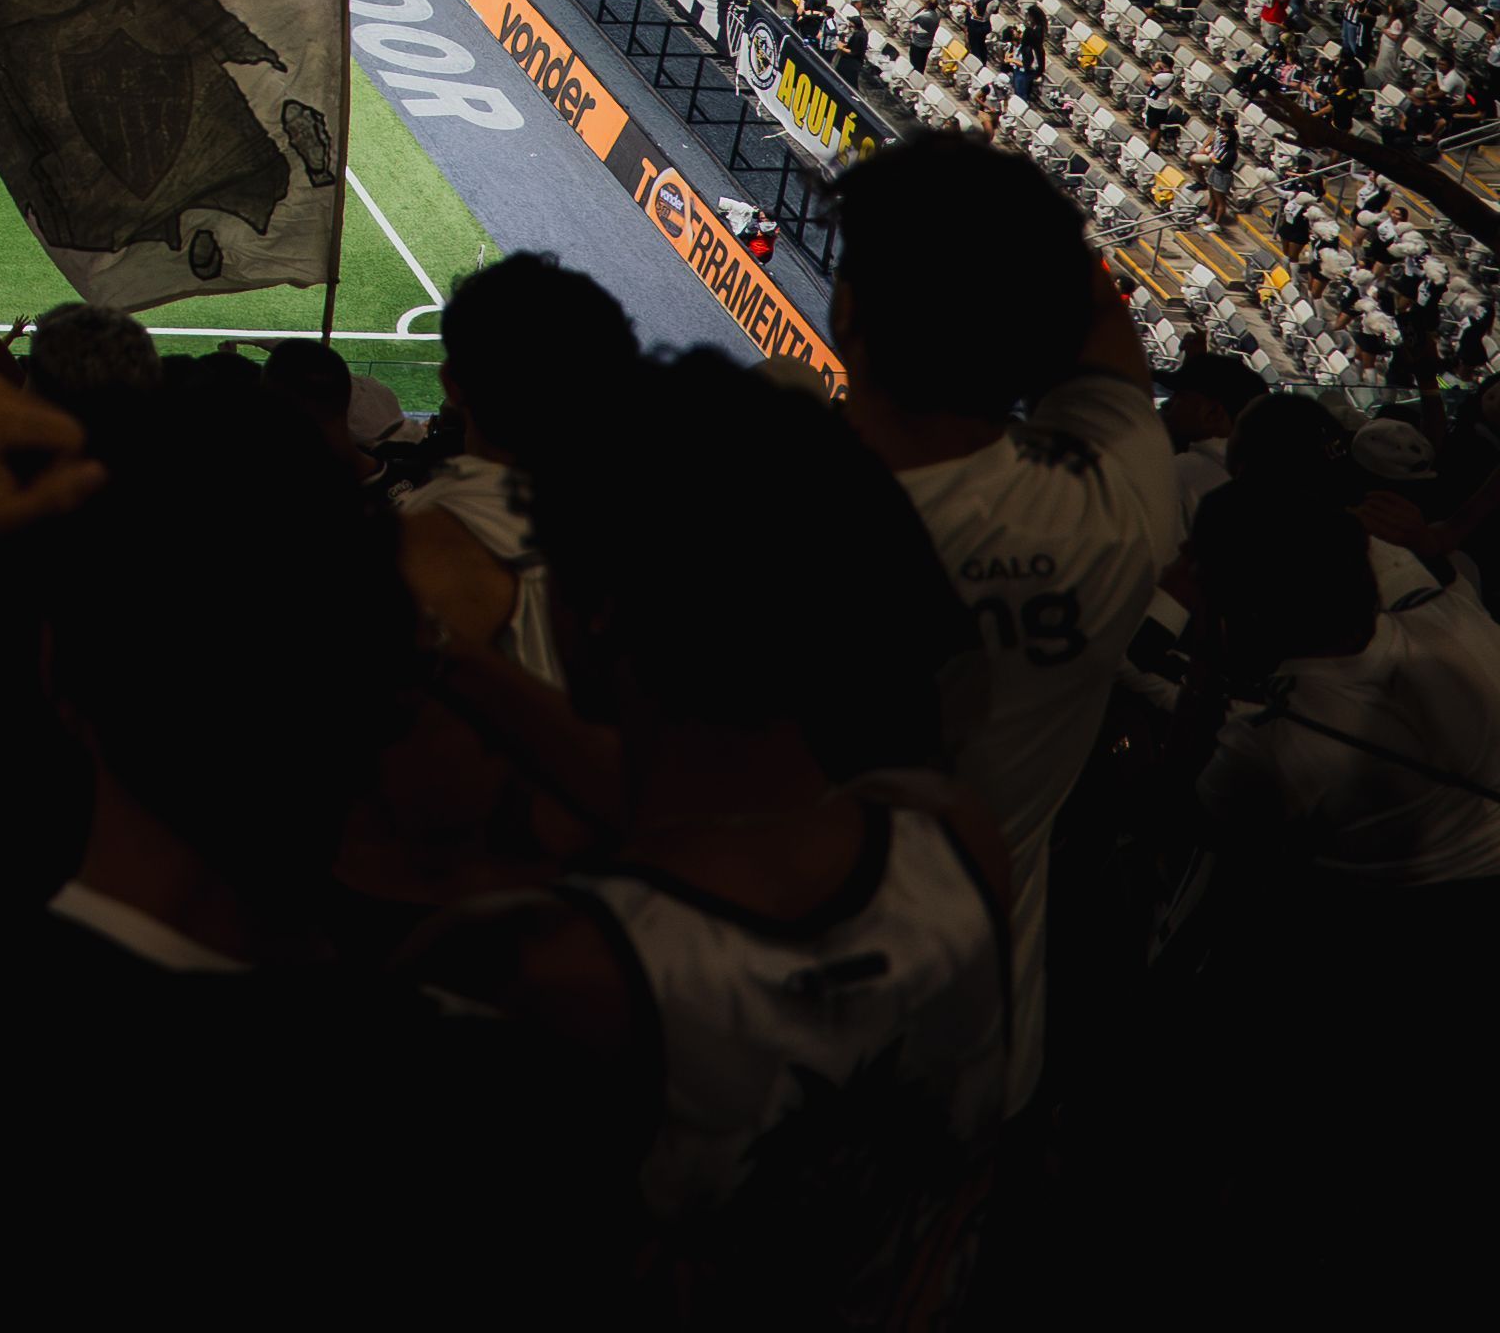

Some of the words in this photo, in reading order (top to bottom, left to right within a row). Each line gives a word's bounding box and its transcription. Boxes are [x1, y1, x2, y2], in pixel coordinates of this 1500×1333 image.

[500, 1, 597, 133] vonder
[777, 57, 837, 146] AQUI
[962, 556, 1057, 582] GALO
